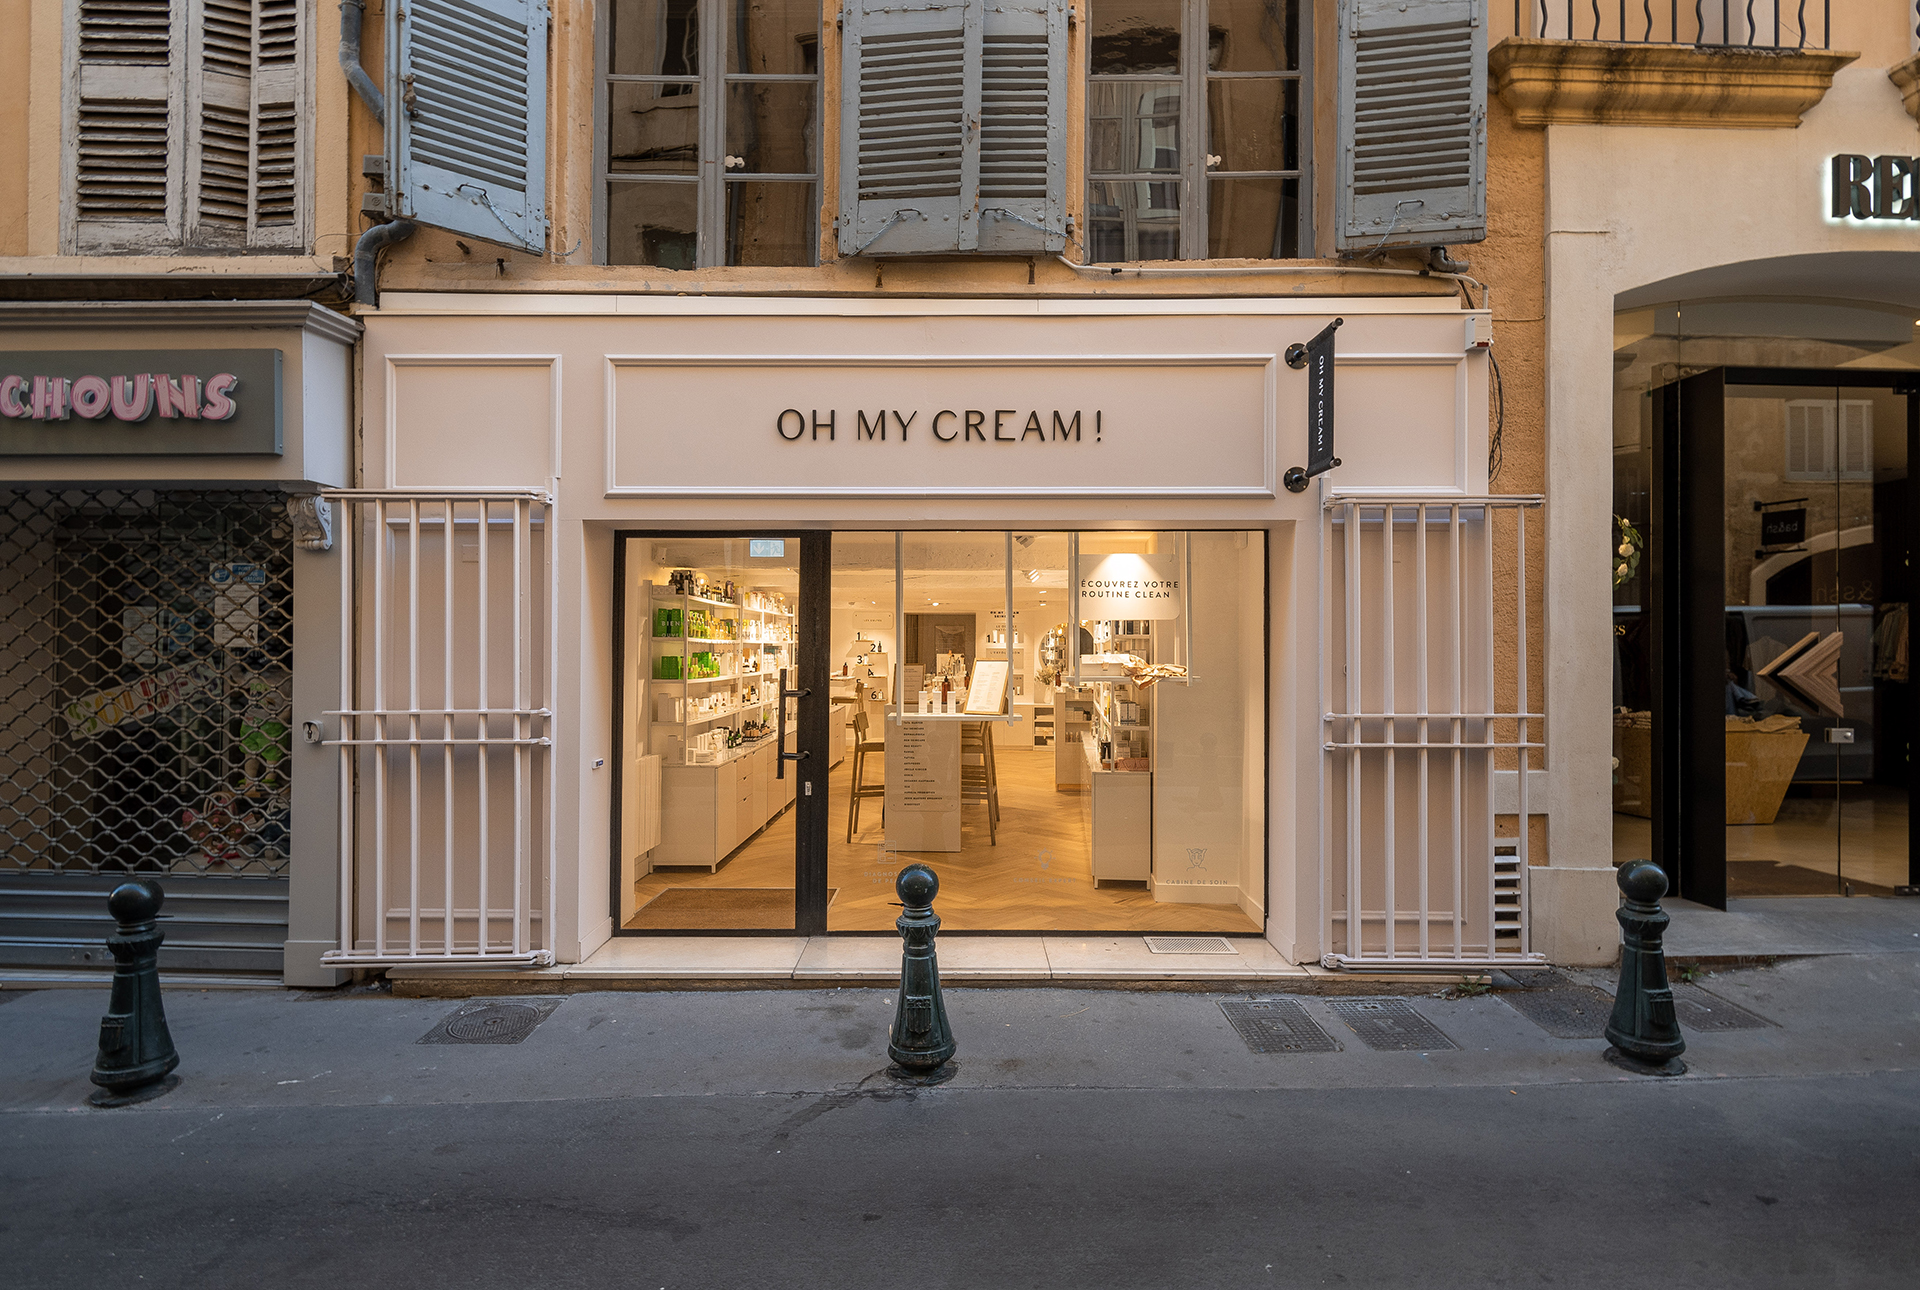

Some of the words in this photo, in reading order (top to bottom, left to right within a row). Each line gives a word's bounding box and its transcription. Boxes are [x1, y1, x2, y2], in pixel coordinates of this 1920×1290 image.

[1831, 153, 1920, 221] RE
[1318, 355, 1325, 375] OH
[1318, 378, 1324, 397] MY
[0, 373, 238, 421] CHOUNS
[777, 408, 835, 441] OH
[857, 409, 917, 441] MY
[1081, 579, 1138, 588] ÉCOUVREZ
[1082, 590, 1130, 598] ROUTINE
[870, 643, 876, 652] 2
[857, 655, 862, 664] 3
[871, 691, 877, 699] 6
